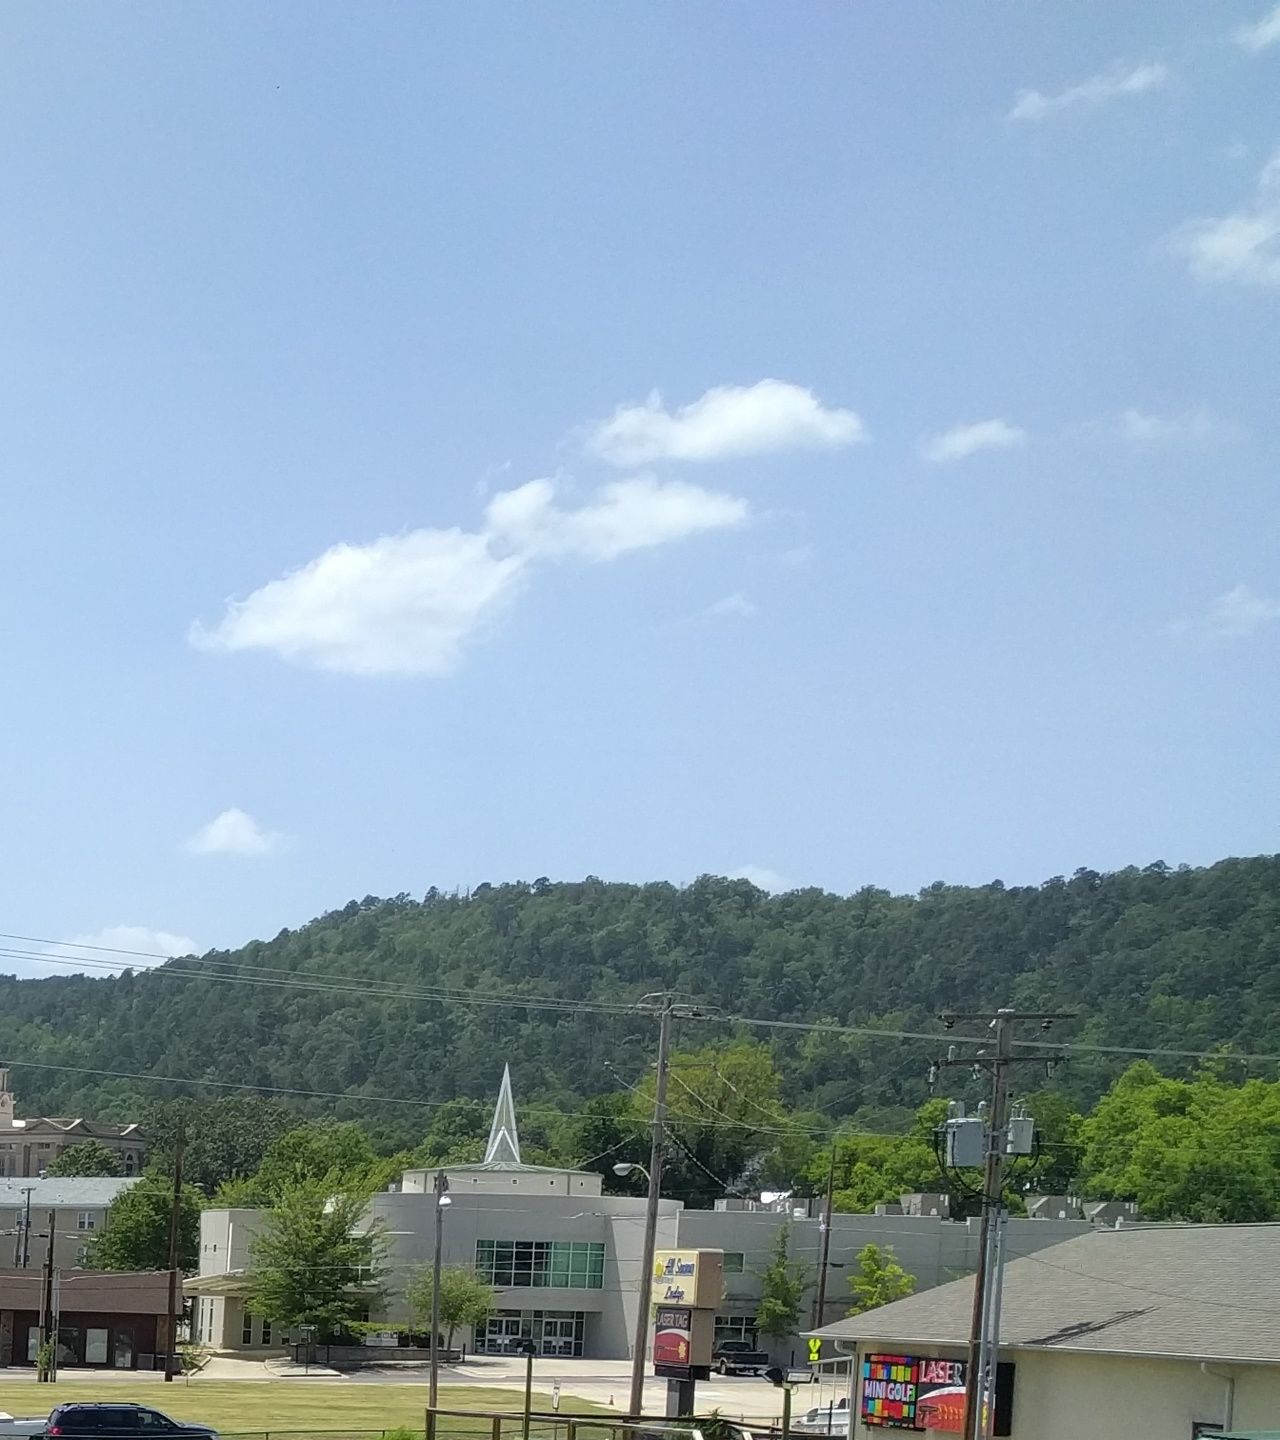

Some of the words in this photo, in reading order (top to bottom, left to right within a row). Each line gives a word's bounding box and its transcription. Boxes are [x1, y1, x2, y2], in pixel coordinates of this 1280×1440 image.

[657, 1311, 674, 1327] LASER
[675, 1314, 688, 1328] TAG
[919, 1360, 963, 1386] LASER
[864, 1380, 886, 1399] MINI
[889, 1382, 915, 1401] GOLF
